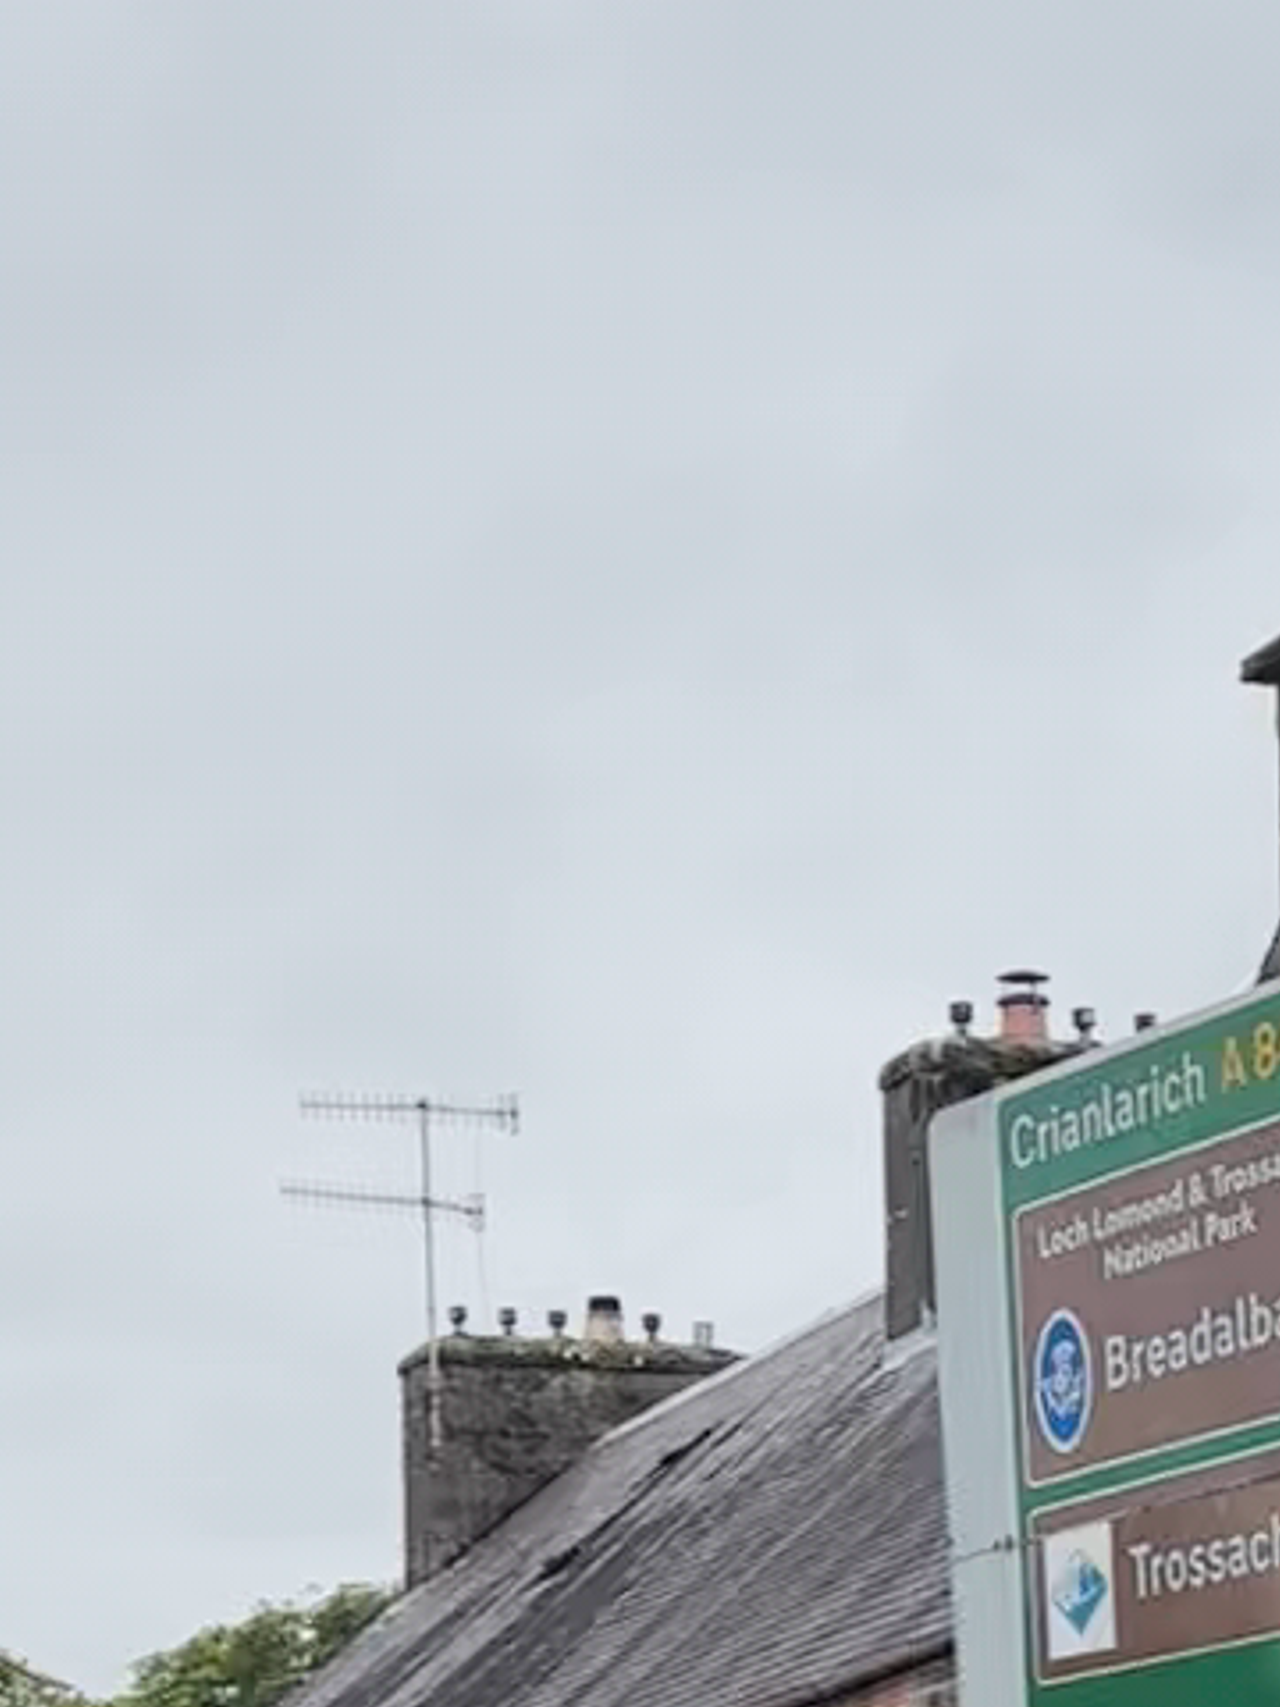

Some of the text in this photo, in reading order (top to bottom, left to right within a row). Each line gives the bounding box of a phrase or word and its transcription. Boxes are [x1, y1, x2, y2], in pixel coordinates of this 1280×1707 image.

[1008, 1053, 1208, 1171] Crianlarich
[1036, 1213, 1090, 1261] Loch
[1093, 1182, 1187, 1243] Lomond
[1188, 1176, 1208, 1213] &
[1103, 1206, 1258, 1281] National Park
